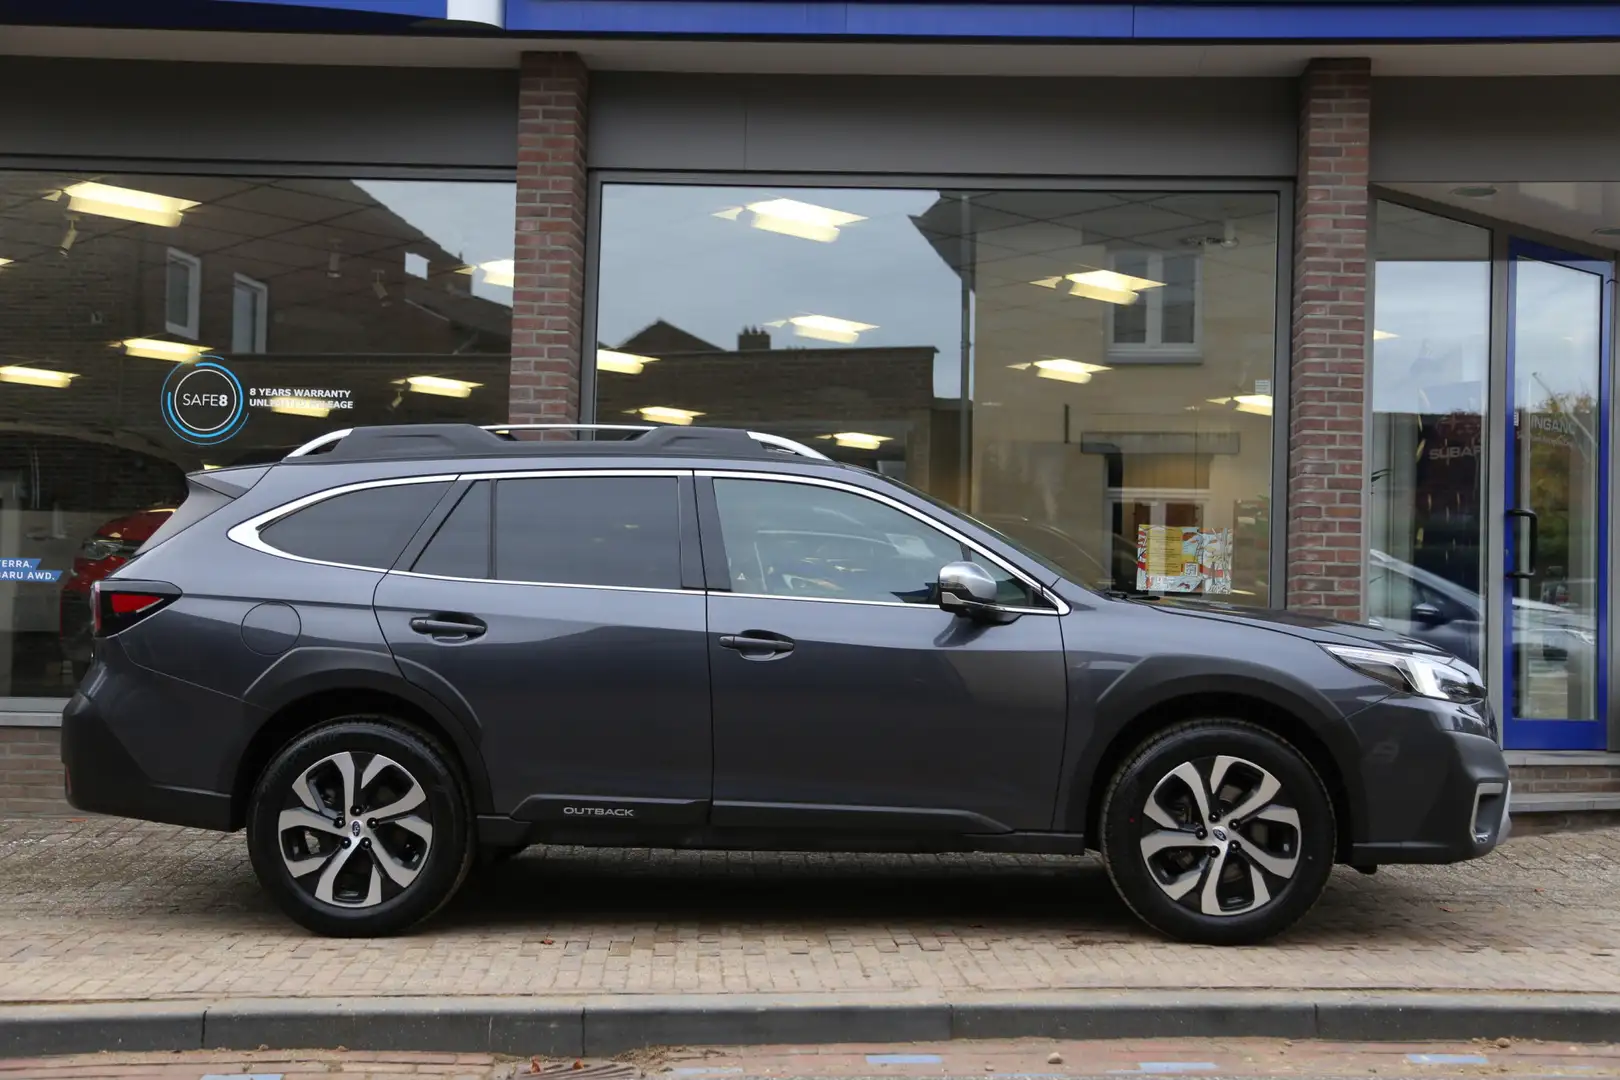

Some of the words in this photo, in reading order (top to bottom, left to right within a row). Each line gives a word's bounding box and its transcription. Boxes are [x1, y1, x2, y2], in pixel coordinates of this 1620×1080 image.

[249, 388, 257, 397] 8
[259, 388, 292, 397] YEARS
[294, 389, 351, 399] WARRANTY
[182, 393, 228, 407] SAFE8
[0, 559, 33, 569] ERRA.
[0, 570, 24, 580] ARU
[27, 571, 56, 581] AWD.
[563, 806, 635, 817] OUTBACK
